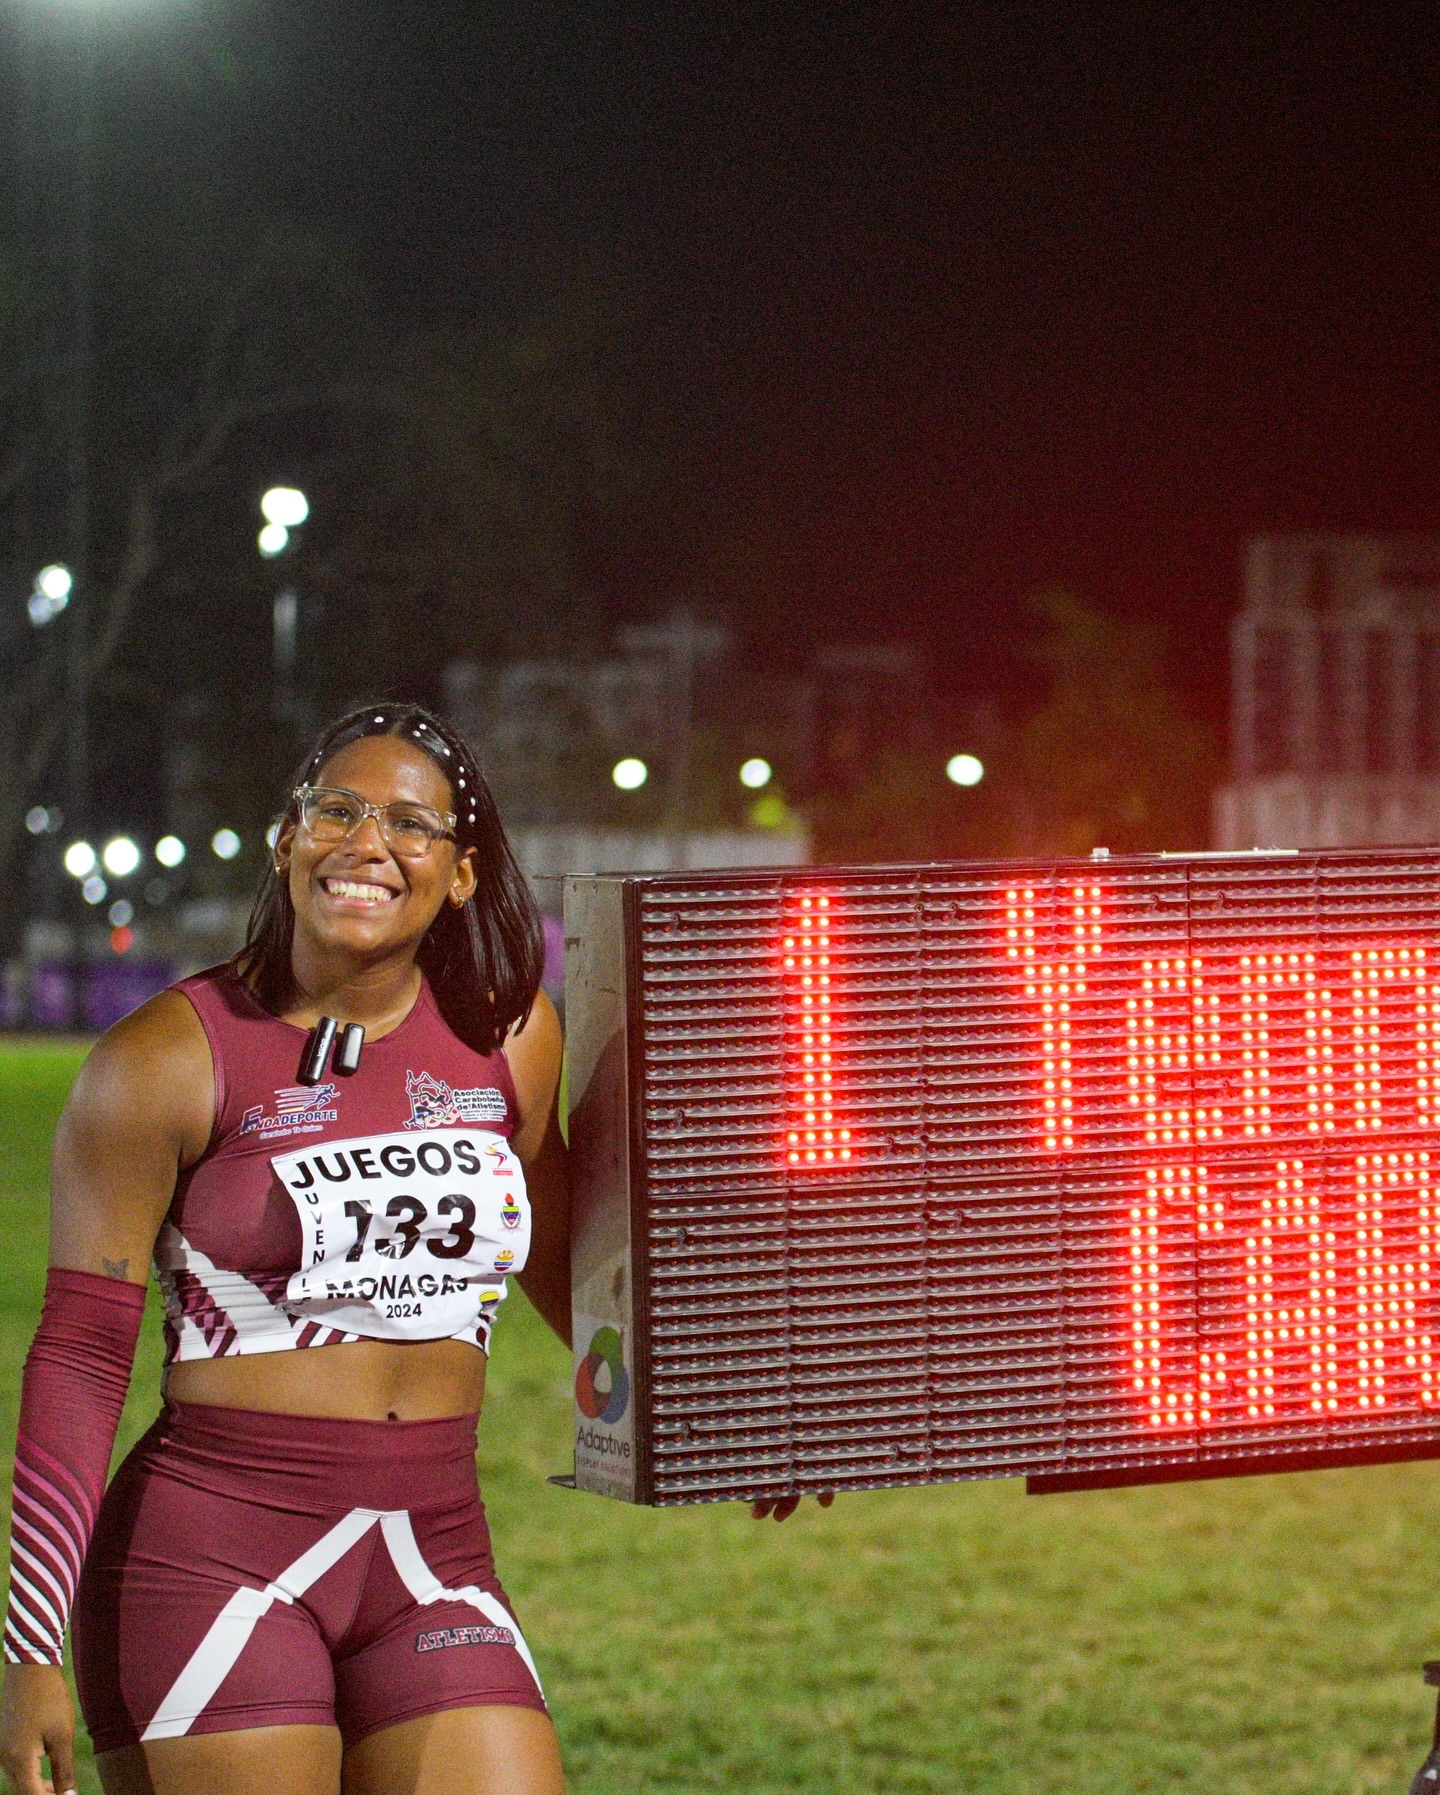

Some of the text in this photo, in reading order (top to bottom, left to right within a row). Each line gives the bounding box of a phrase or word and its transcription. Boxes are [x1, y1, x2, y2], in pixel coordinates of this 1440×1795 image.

[290, 1139, 481, 1189] JUEGOS
[343, 1194, 476, 1262] 133
[386, 1303, 422, 1319] 2024
[577, 1424, 631, 1458] Adaptive
[417, 1626, 515, 1652] ATLETISMO
